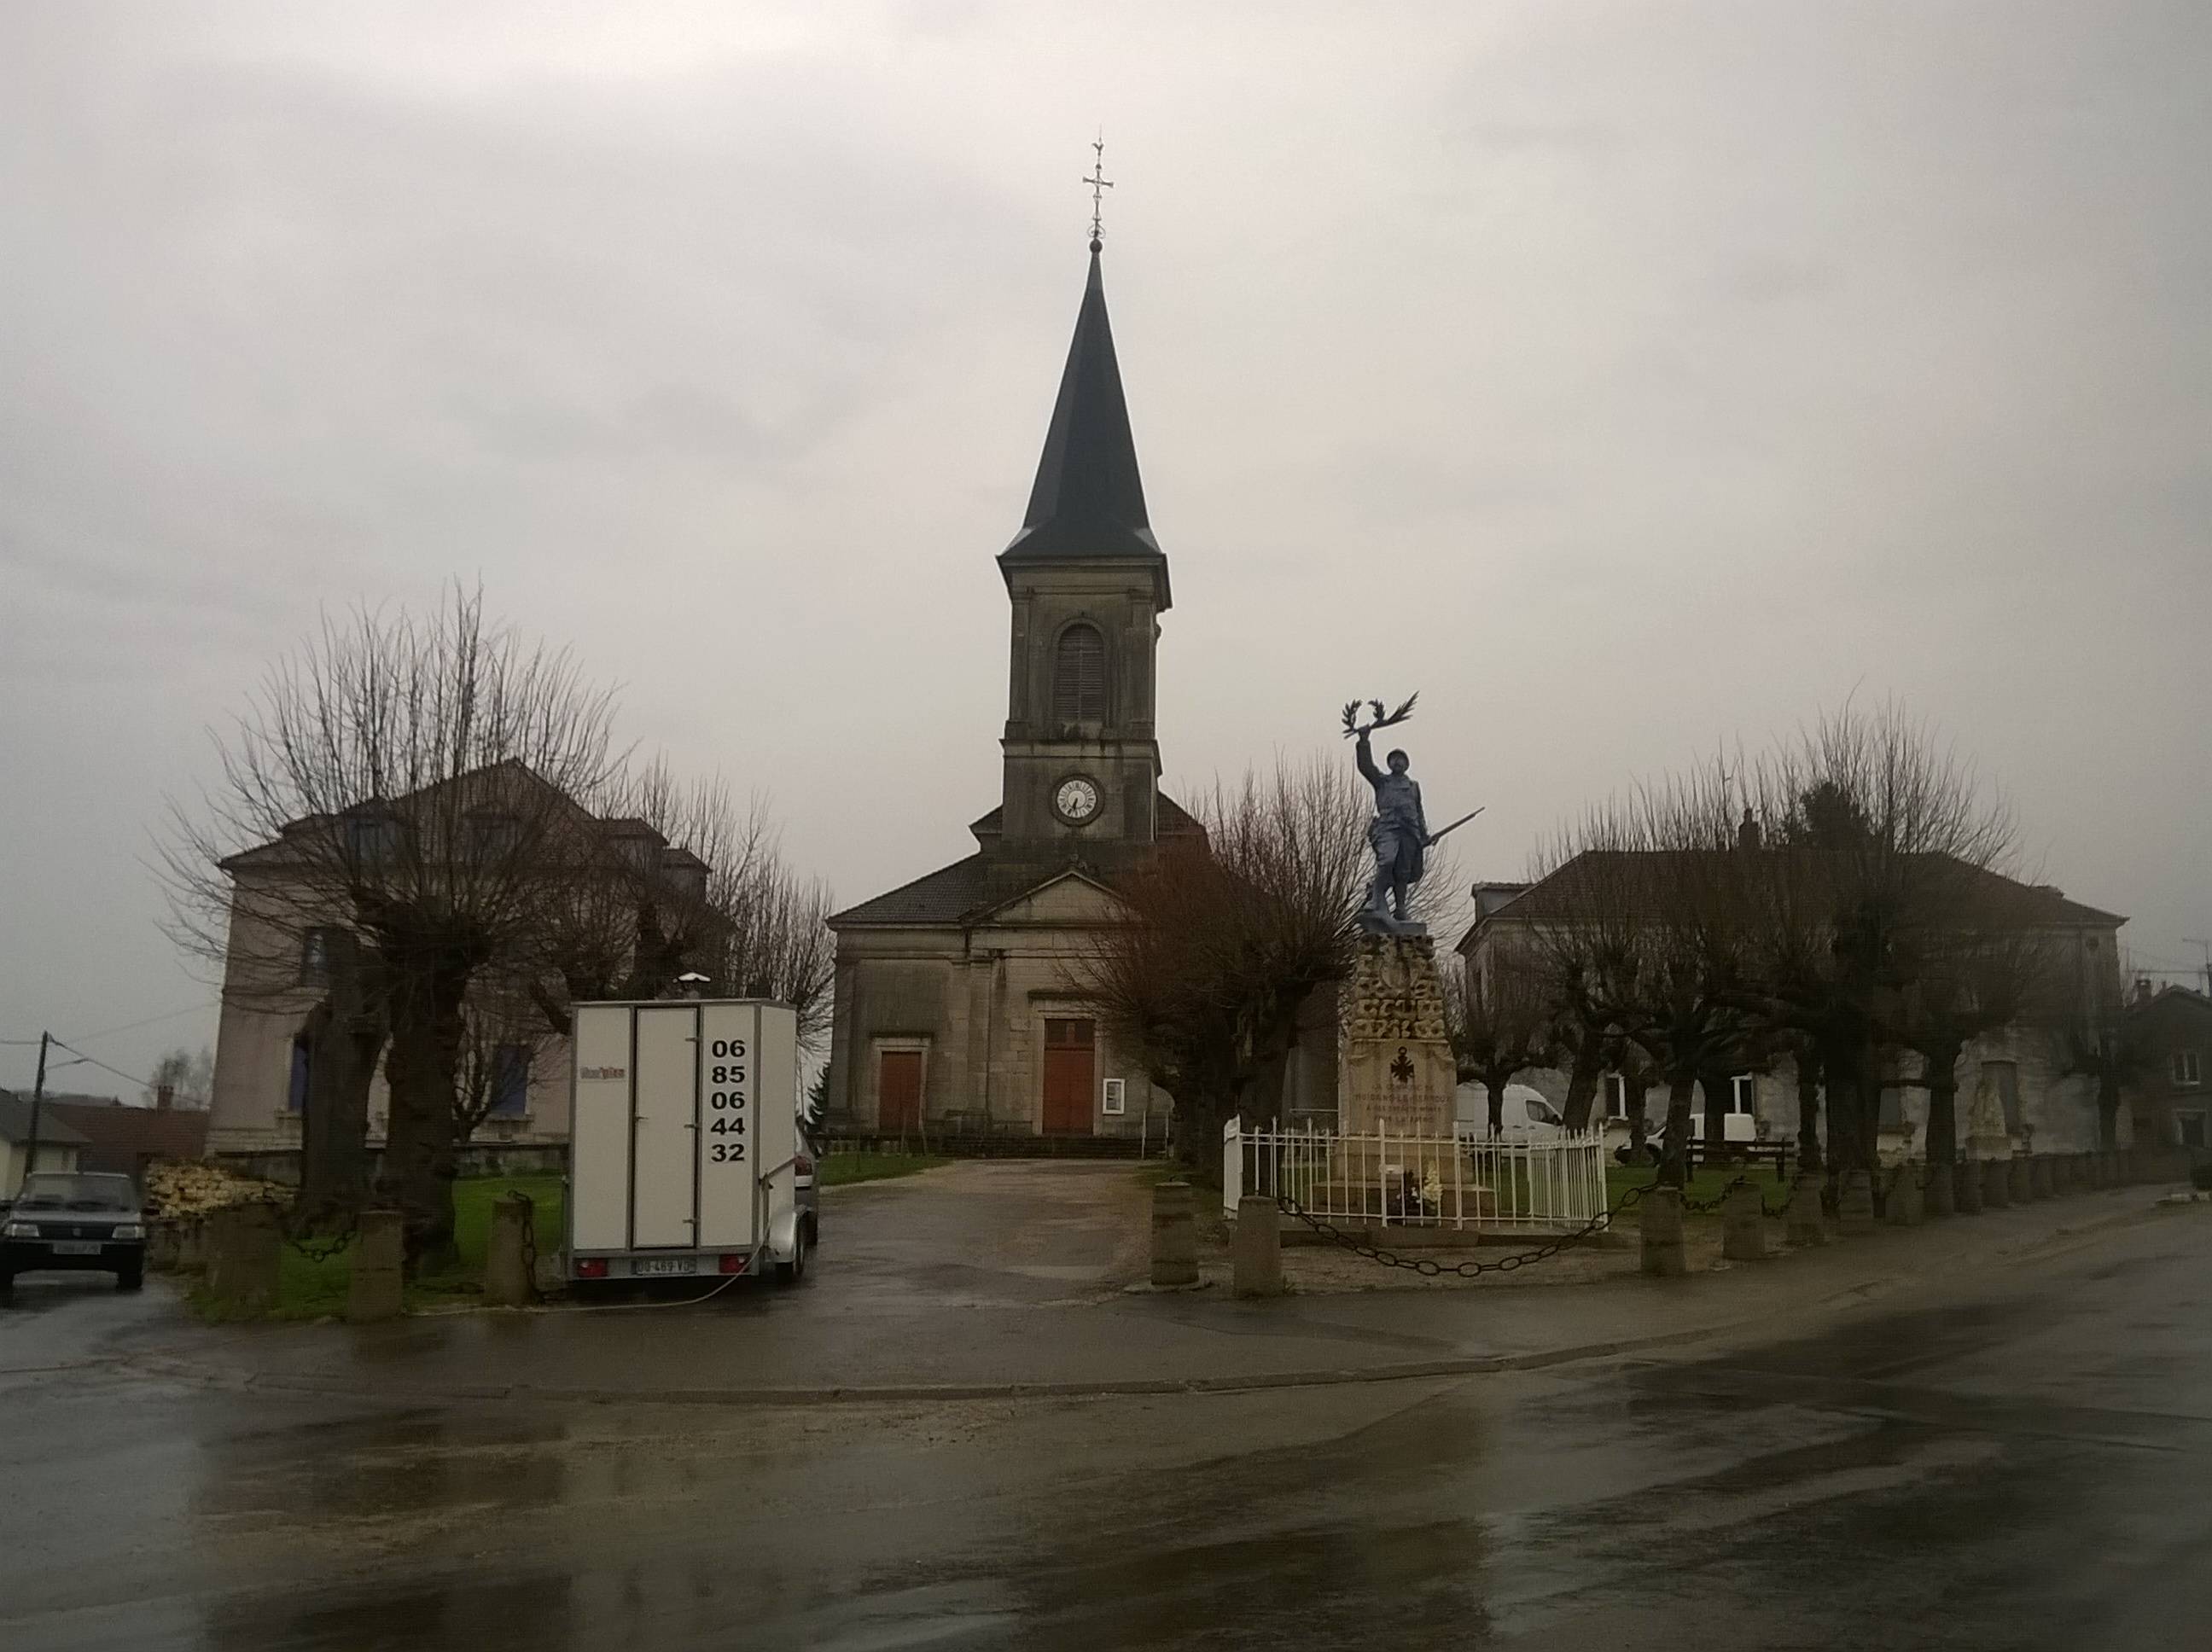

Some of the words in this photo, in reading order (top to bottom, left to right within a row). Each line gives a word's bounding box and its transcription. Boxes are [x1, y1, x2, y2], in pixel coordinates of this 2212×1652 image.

[712, 1039, 746, 1058] 06
[712, 1065, 746, 1084] 85
[711, 1091, 746, 1110] 06
[710, 1117, 746, 1136] 44
[711, 1143, 745, 1162] 32
